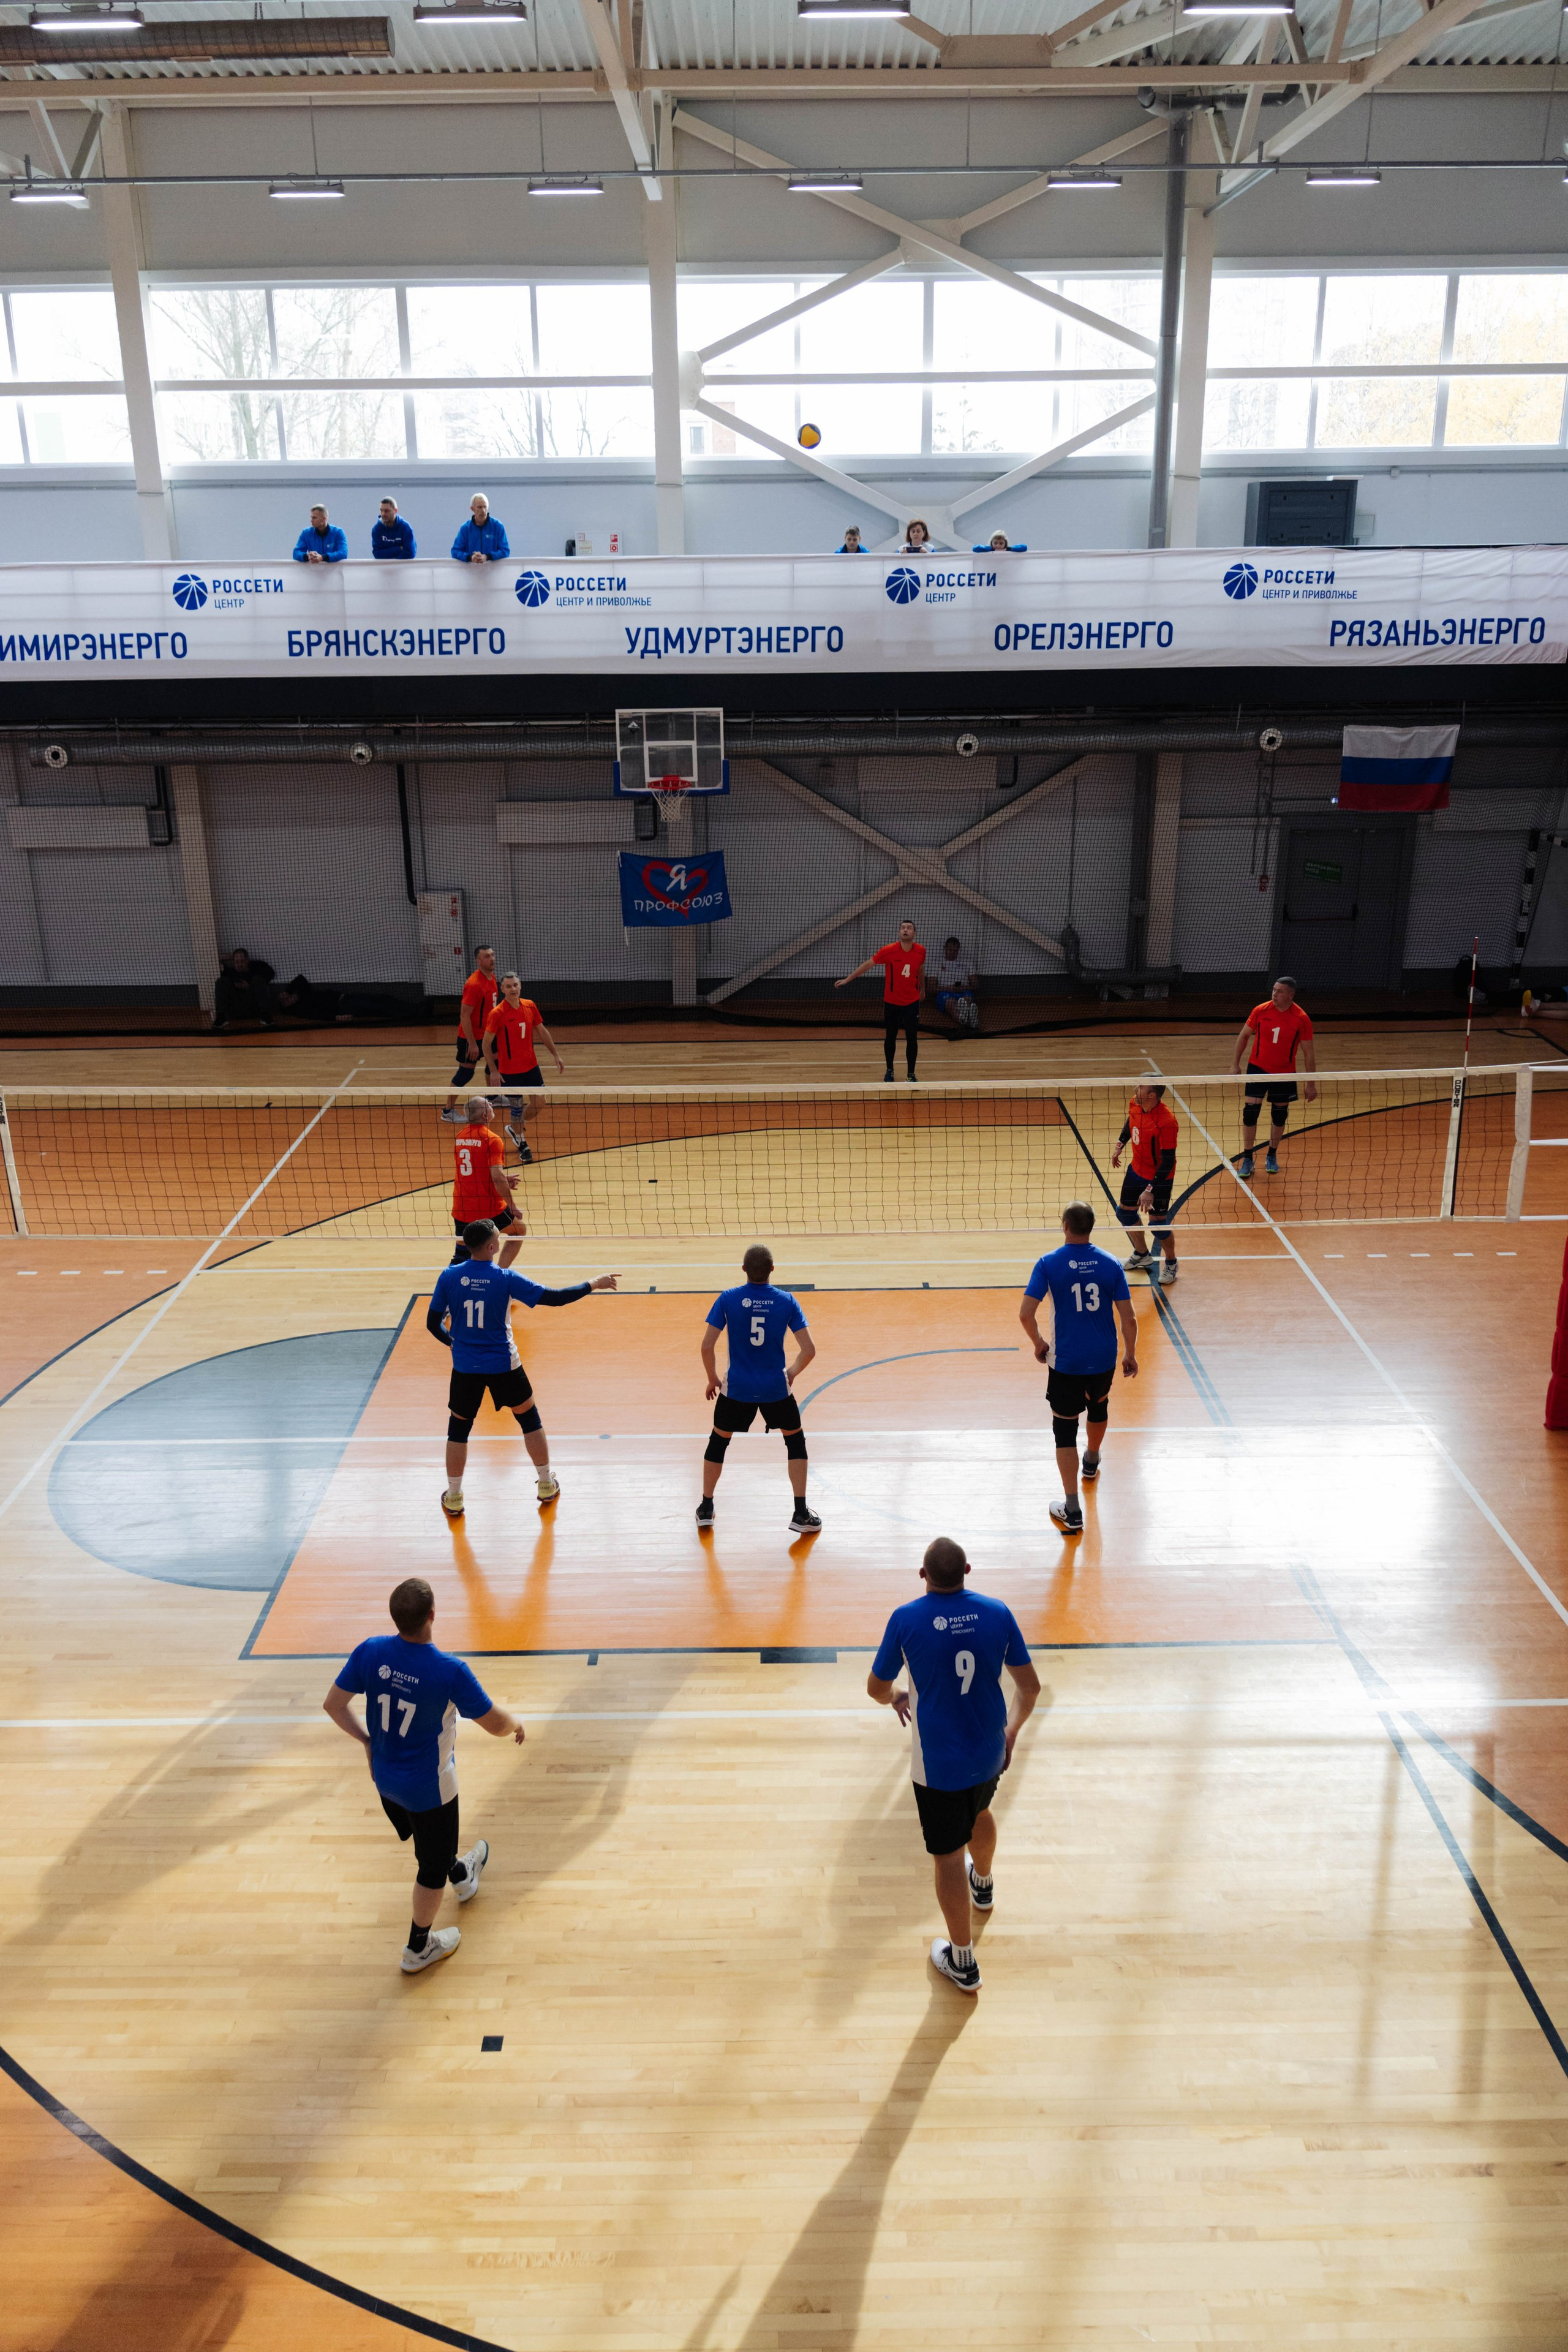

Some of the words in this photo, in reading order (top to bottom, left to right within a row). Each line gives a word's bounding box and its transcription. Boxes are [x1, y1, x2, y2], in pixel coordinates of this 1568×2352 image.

[556, 577, 627, 591] РОССЕТИ
[926, 573, 997, 587] РОССЕТИ
[1264, 569, 1335, 584] РОССЕТИ
[213, 579, 284, 594] РОССЕТИ
[1262, 589, 1291, 600] ЦЕНТР
[1293, 590, 1299, 598] И
[1302, 590, 1358, 599] ПРИВОЛЖЬЕ
[214, 598, 244, 610] ЦЕНТР
[556, 597, 584, 607] ЦЕНТР
[587, 597, 593, 606] И
[596, 597, 652, 606] ПРИВОЛЖЬЕ
[925, 593, 956, 604] ЦЕНТР
[994, 621, 1174, 650] ОРЕЛЭНЕРГО
[1330, 617, 1545, 647] РЯЗАНЬЭНЕРГО
[287, 628, 505, 657] БРЯНСКЭНЕРГО
[625, 626, 843, 659] УДМУРТЭНЕРГО
[666, 864, 688, 892] Я
[634, 892, 723, 912] ПРОФСОЮЗ
[901, 963, 911, 978] 4
[1272, 1027, 1281, 1044] 1
[1132, 1126, 1140, 1145] 6
[459, 1148, 472, 1176] 3
[1071, 1282, 1100, 1312] 13
[464, 1300, 484, 1329] 11
[750, 1316, 766, 1346] 5
[949, 1613, 979, 1624] РОССЕТИ
[393, 1670, 420, 1684] РОССЕТИ
[955, 1649, 976, 1695] 9
[377, 1693, 417, 1738] 17
